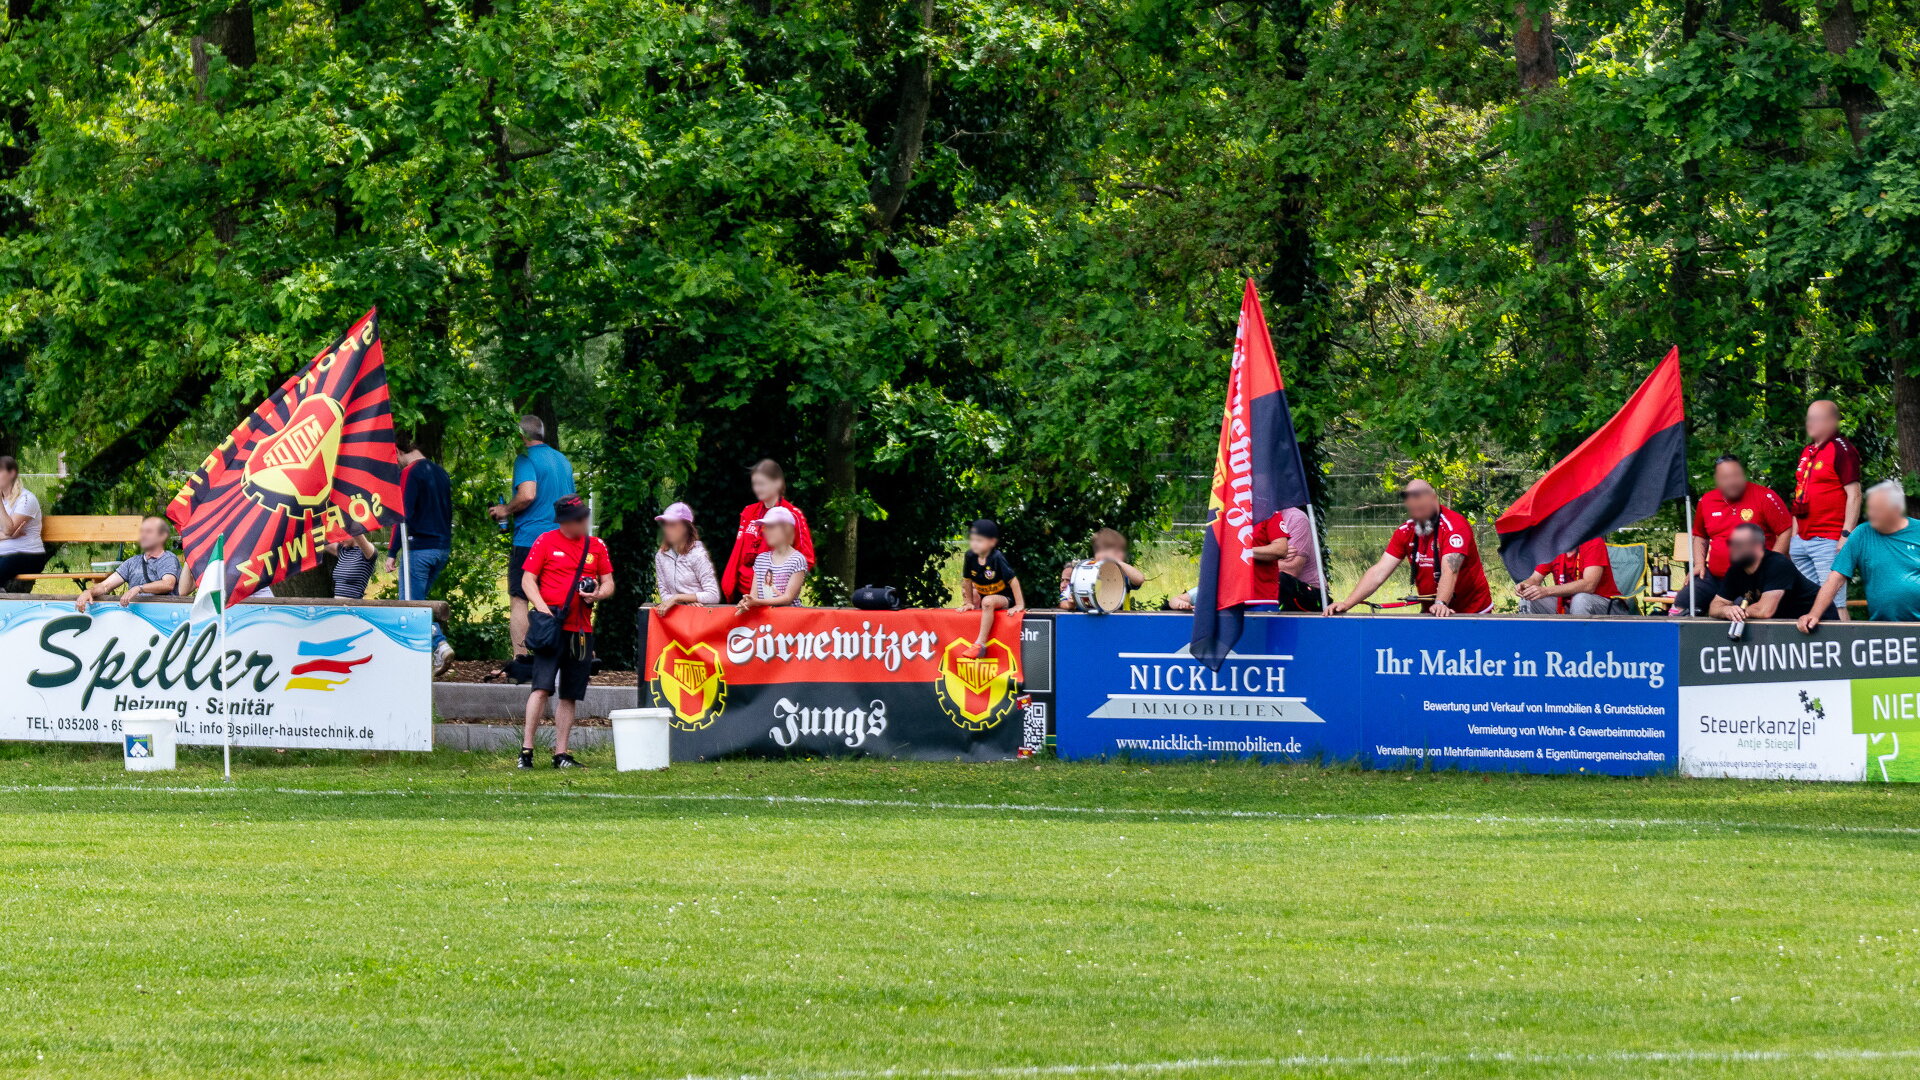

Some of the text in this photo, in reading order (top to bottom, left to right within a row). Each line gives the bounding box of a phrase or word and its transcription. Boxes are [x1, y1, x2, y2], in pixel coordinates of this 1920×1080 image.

[726, 620, 938, 672] Sörnewitzer
[1700, 636, 1920, 674] GEWINNER GEBE
[27, 614, 280, 711] Spiller
[673, 658, 707, 691] MOTOR
[956, 657, 999, 690] MOTOR
[1375, 647, 1665, 688] Ihr Makler in Radeburg
[1129, 664, 1285, 693] NICKLICH
[114, 694, 188, 717] Heizung
[205, 697, 274, 716] Sanitär
[1131, 702, 1284, 718] IMMOBILIEN
[1423, 700, 1665, 715] Bewertung und Verkauf von Immobilien & Grundstücken
[1872, 692, 1920, 720] NIE
[26, 716, 53, 730] TEL:
[57, 717, 99, 731] 035208
[199, 720, 374, 740] info@spiller-haustechnik.de
[769, 697, 888, 748] Jungs
[1467, 724, 1665, 738] Vermietung von Wohn- & Gewerbeimmobilien
[1700, 715, 1816, 750] Steuerkanzlei
[1116, 733, 1302, 753] www.nicklich-immobilien.de
[1376, 745, 1665, 762] Verwaltung von Mehrfamilienhäusern & Eigentümergemeinschaften
[1737, 738, 1796, 751] Antje Stiegel
